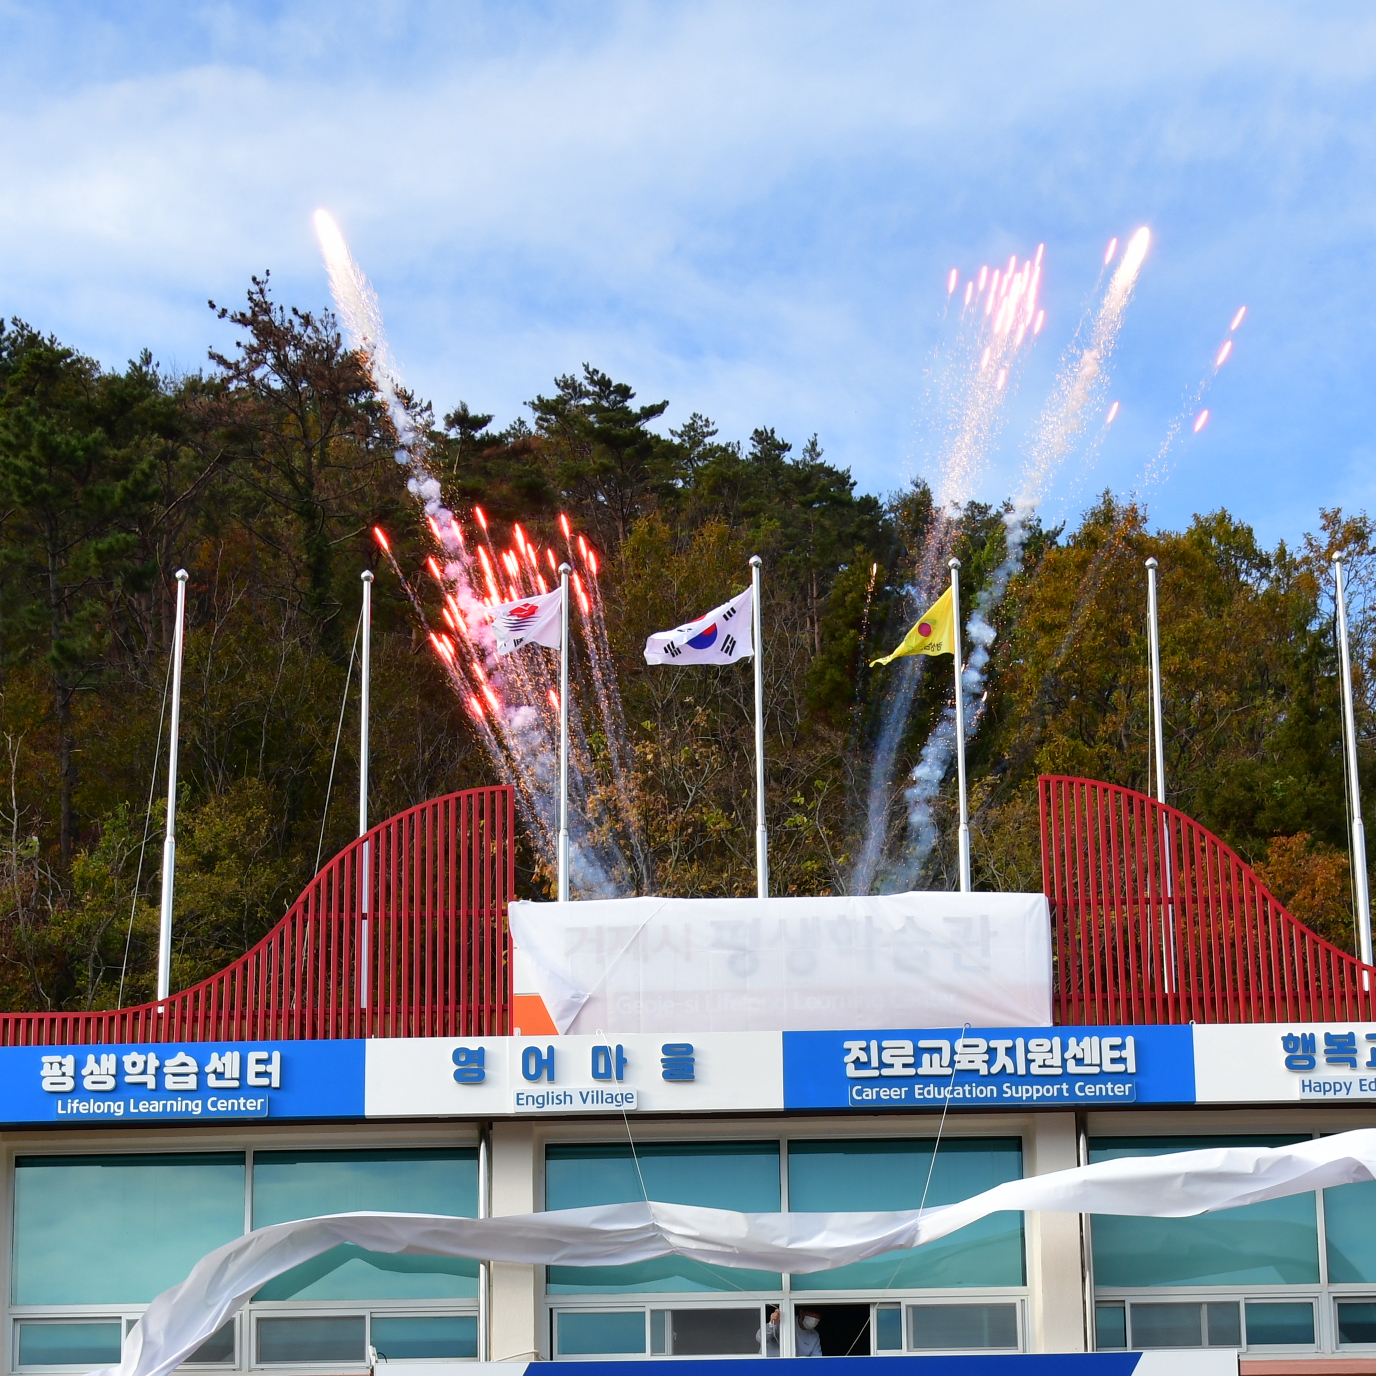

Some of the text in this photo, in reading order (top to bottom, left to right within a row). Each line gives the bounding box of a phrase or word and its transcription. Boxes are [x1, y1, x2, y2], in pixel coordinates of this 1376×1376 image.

[843, 1036, 1137, 1078] 진로교육지원센터
[40, 1051, 281, 1092] 평생학습센터
[852, 1081, 1132, 1101] Career Education Support Center
[1301, 1079, 1353, 1096] Happy
[57, 1096, 265, 1116] Lifelong Learning Center
[516, 1089, 634, 1109] English Village
